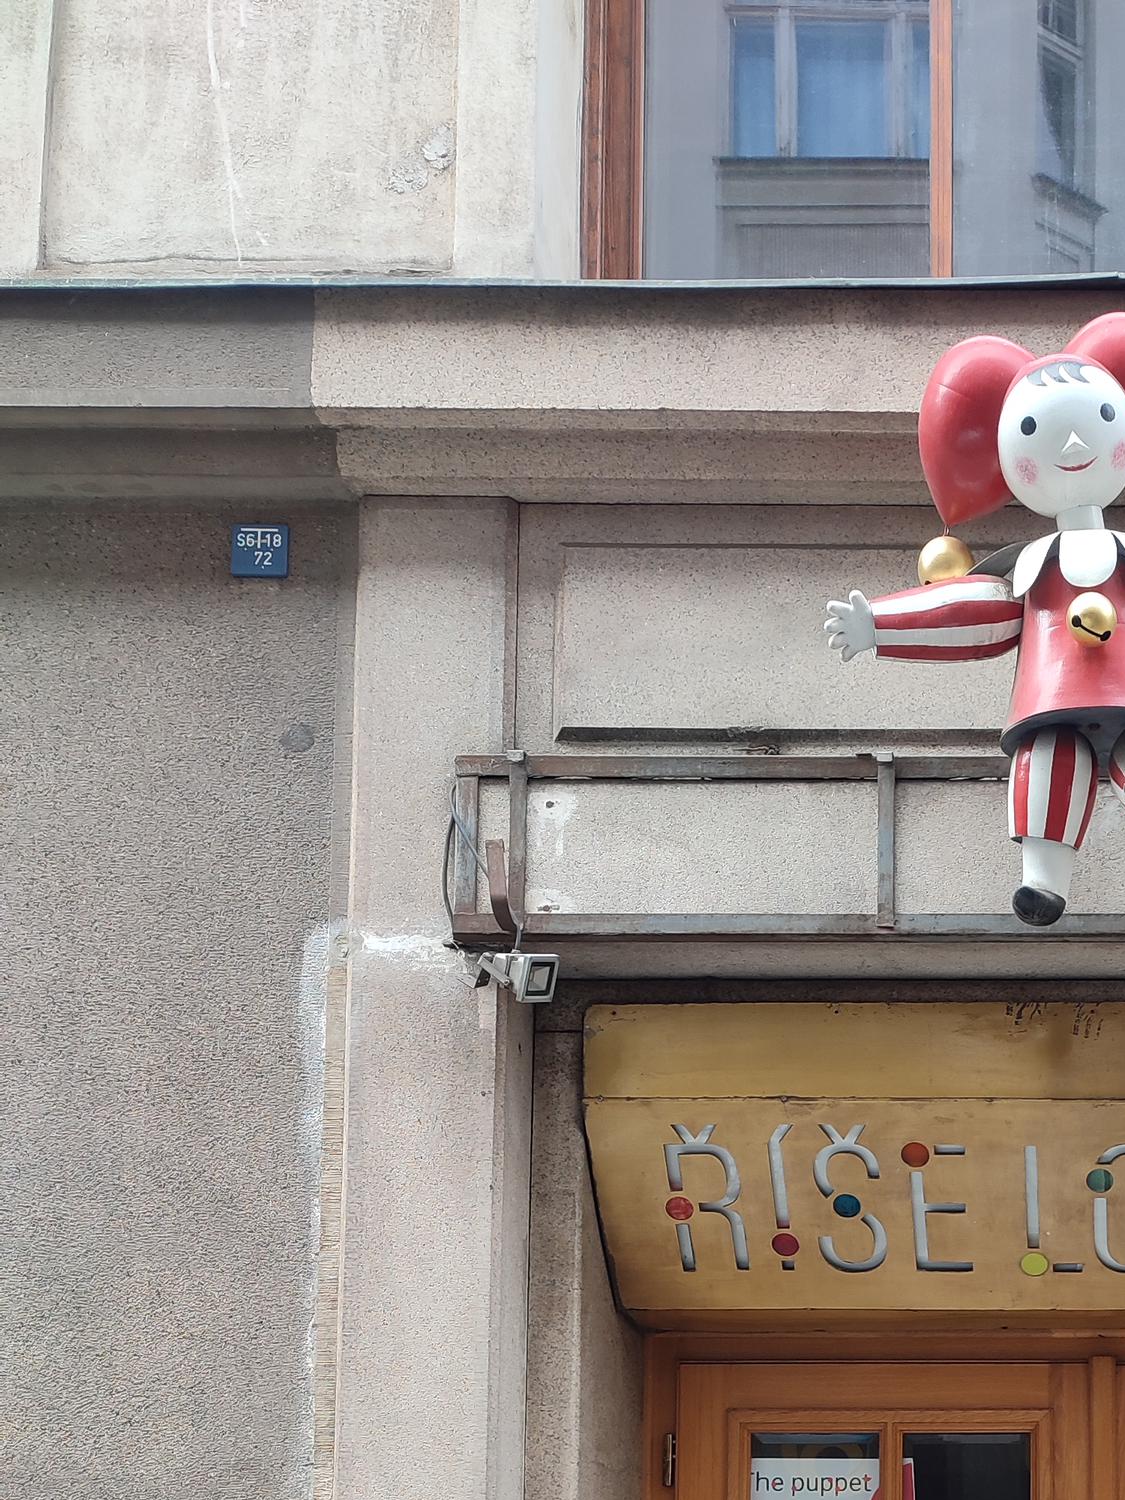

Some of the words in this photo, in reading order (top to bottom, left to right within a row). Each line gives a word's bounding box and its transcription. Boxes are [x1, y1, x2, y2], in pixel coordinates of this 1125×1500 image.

[664, 1123, 973, 1272] ŘÍŠE
[751, 1471, 784, 1492] he
[791, 1474, 872, 1497] puppet
